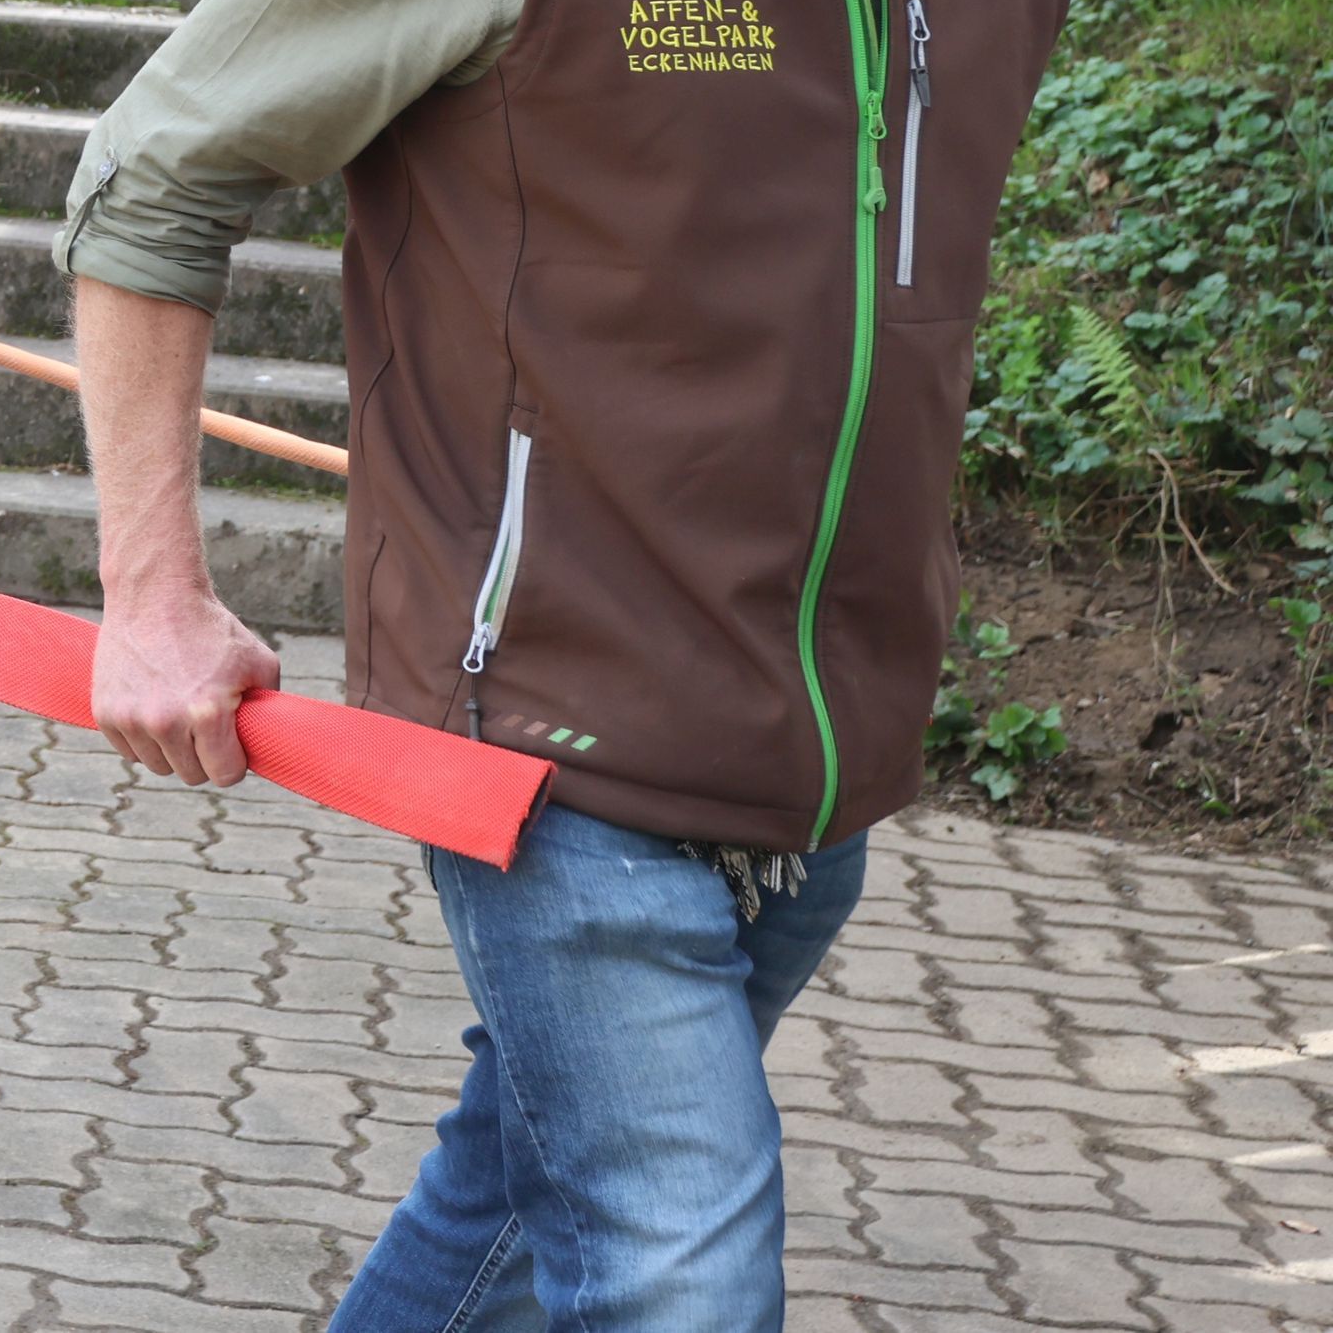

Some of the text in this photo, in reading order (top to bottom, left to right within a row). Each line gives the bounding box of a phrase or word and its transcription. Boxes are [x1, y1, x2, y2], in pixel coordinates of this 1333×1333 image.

[741, 0, 759, 22] &
[620, 24, 776, 50] VOGELPARK
[627, 52, 774, 73] ECKENHAGEN
